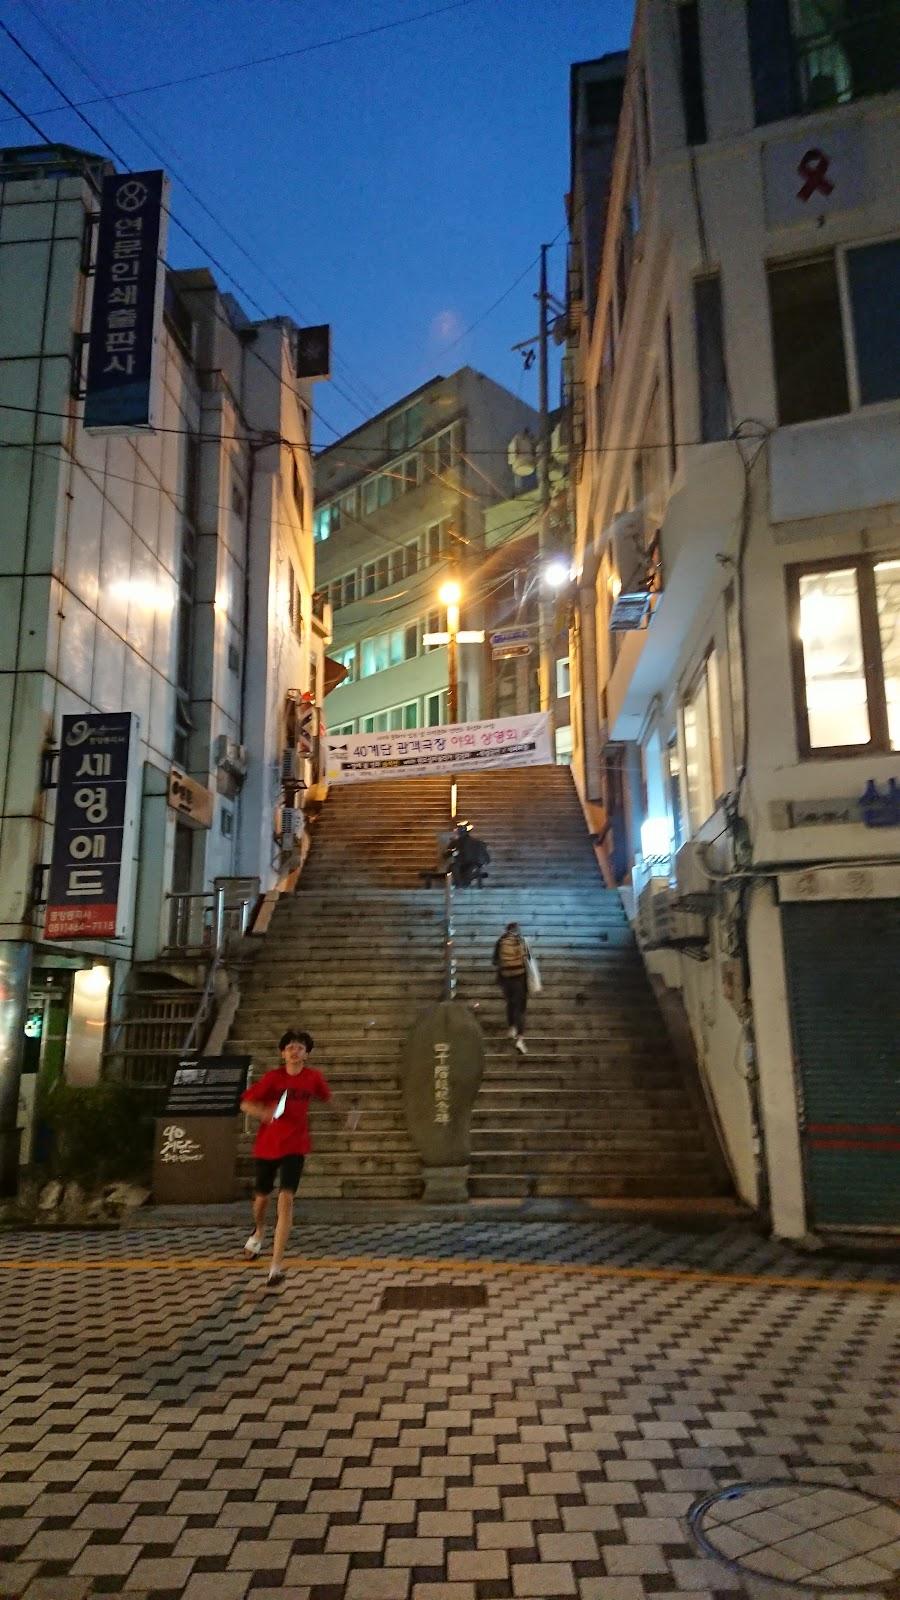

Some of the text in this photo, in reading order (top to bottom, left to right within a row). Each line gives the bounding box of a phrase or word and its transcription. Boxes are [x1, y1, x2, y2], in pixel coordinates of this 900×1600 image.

[353, 743, 392, 758] 40계단
[397, 738, 446, 755] 관객극장
[451, 734, 476, 748] 야외
[481, 728, 517, 746] 상영회
[66, 753, 111, 896] 세영애드
[163, 1125, 186, 1142] 40
